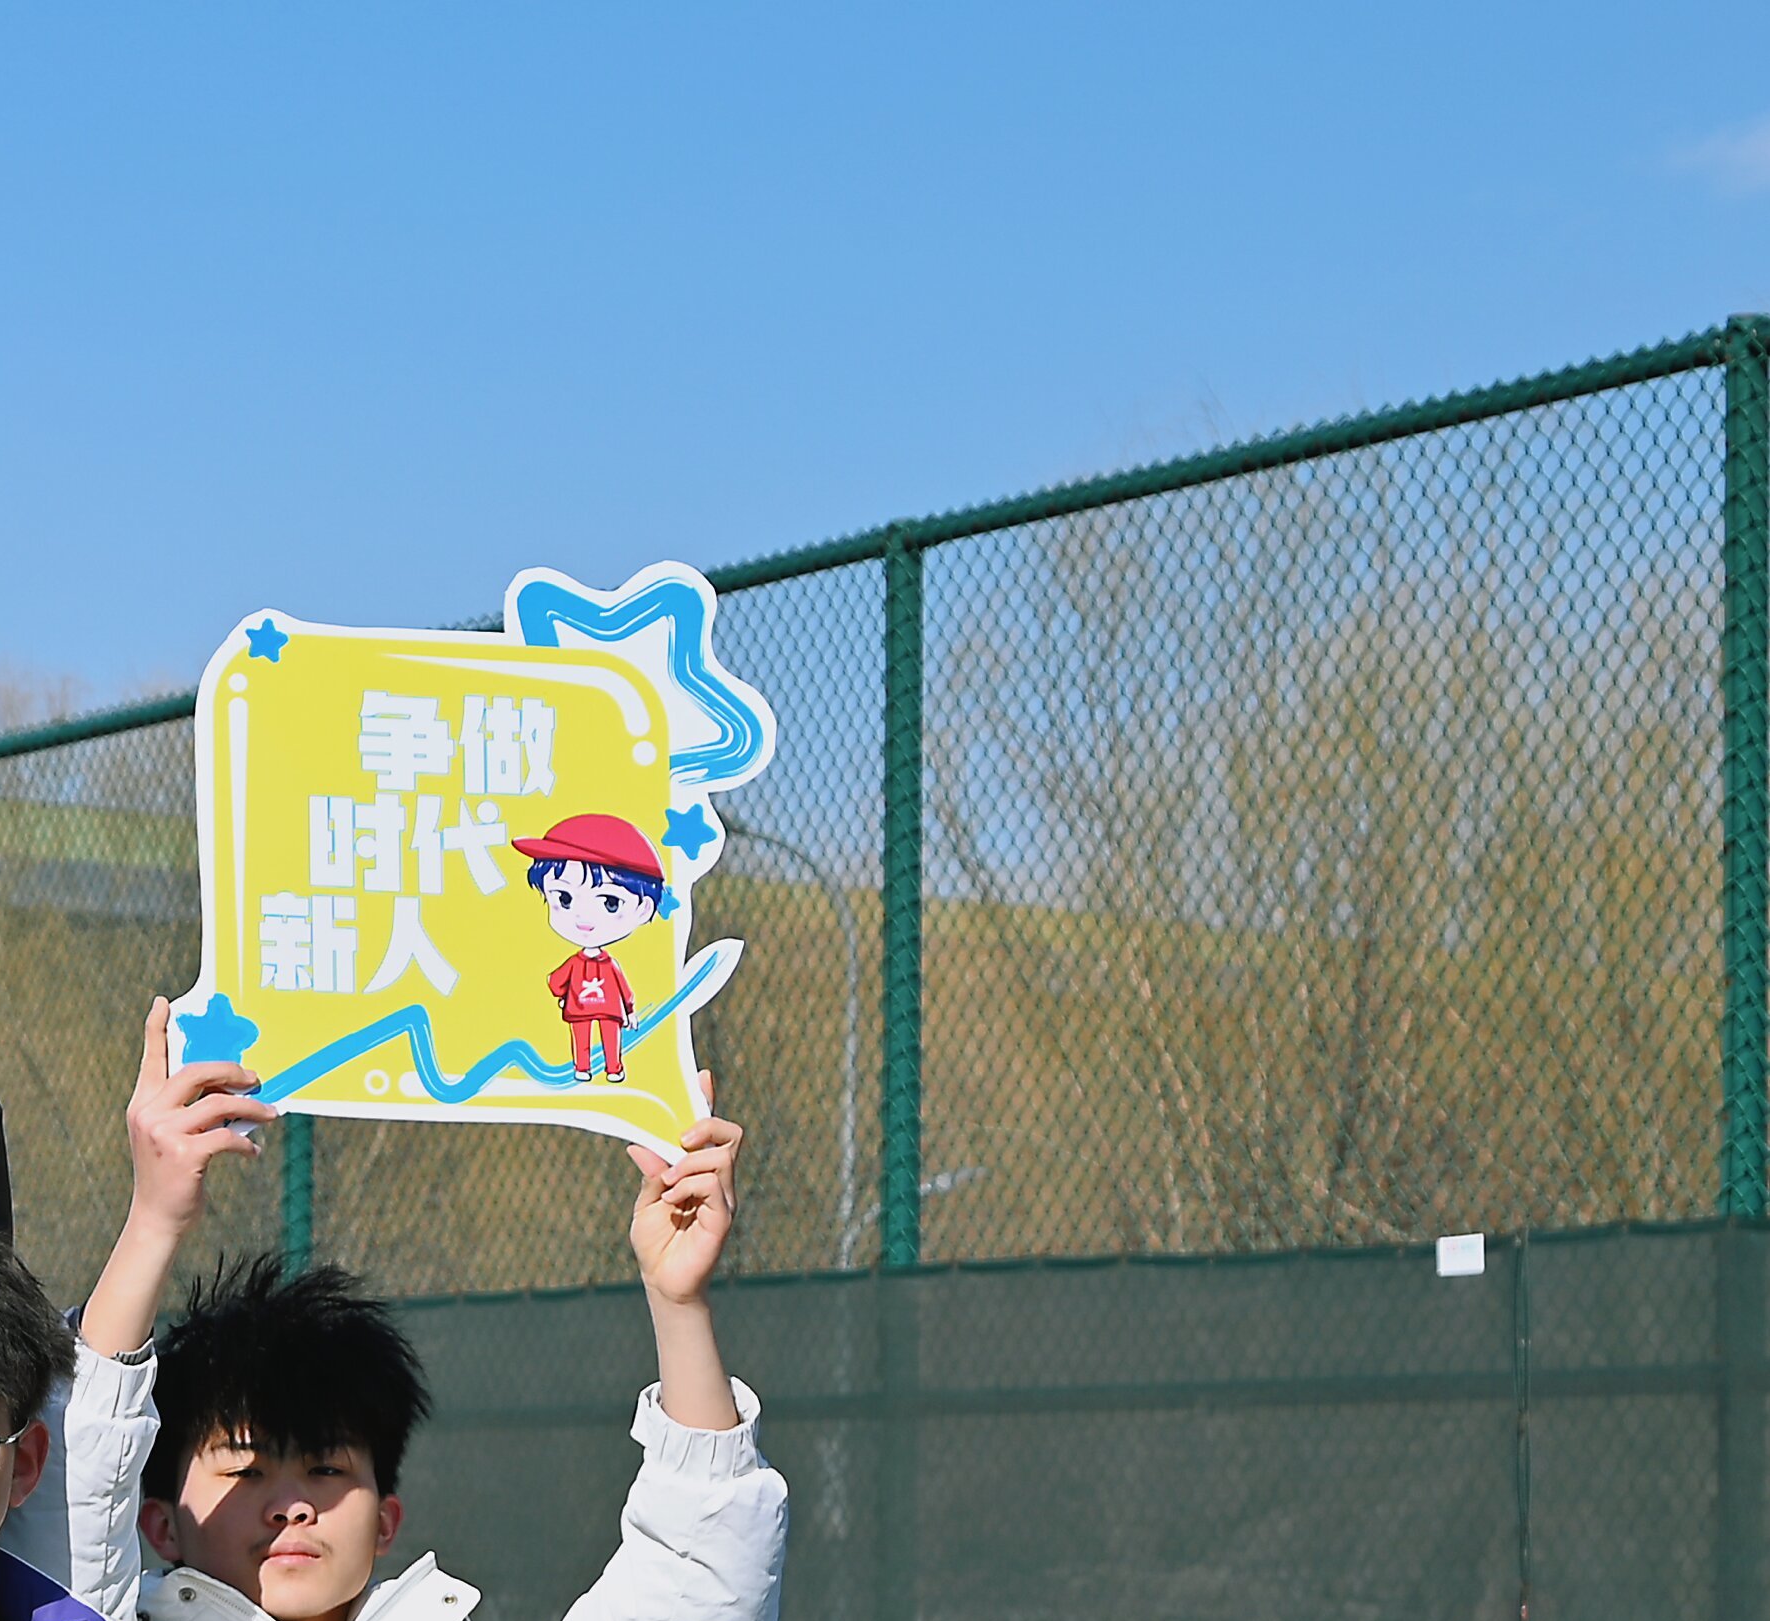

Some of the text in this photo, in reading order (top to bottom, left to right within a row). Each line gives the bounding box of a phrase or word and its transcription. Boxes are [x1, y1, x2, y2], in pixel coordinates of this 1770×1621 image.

[357, 690, 556, 797] 争做
[308, 793, 507, 896] 时代
[258, 892, 461, 998] 新人
